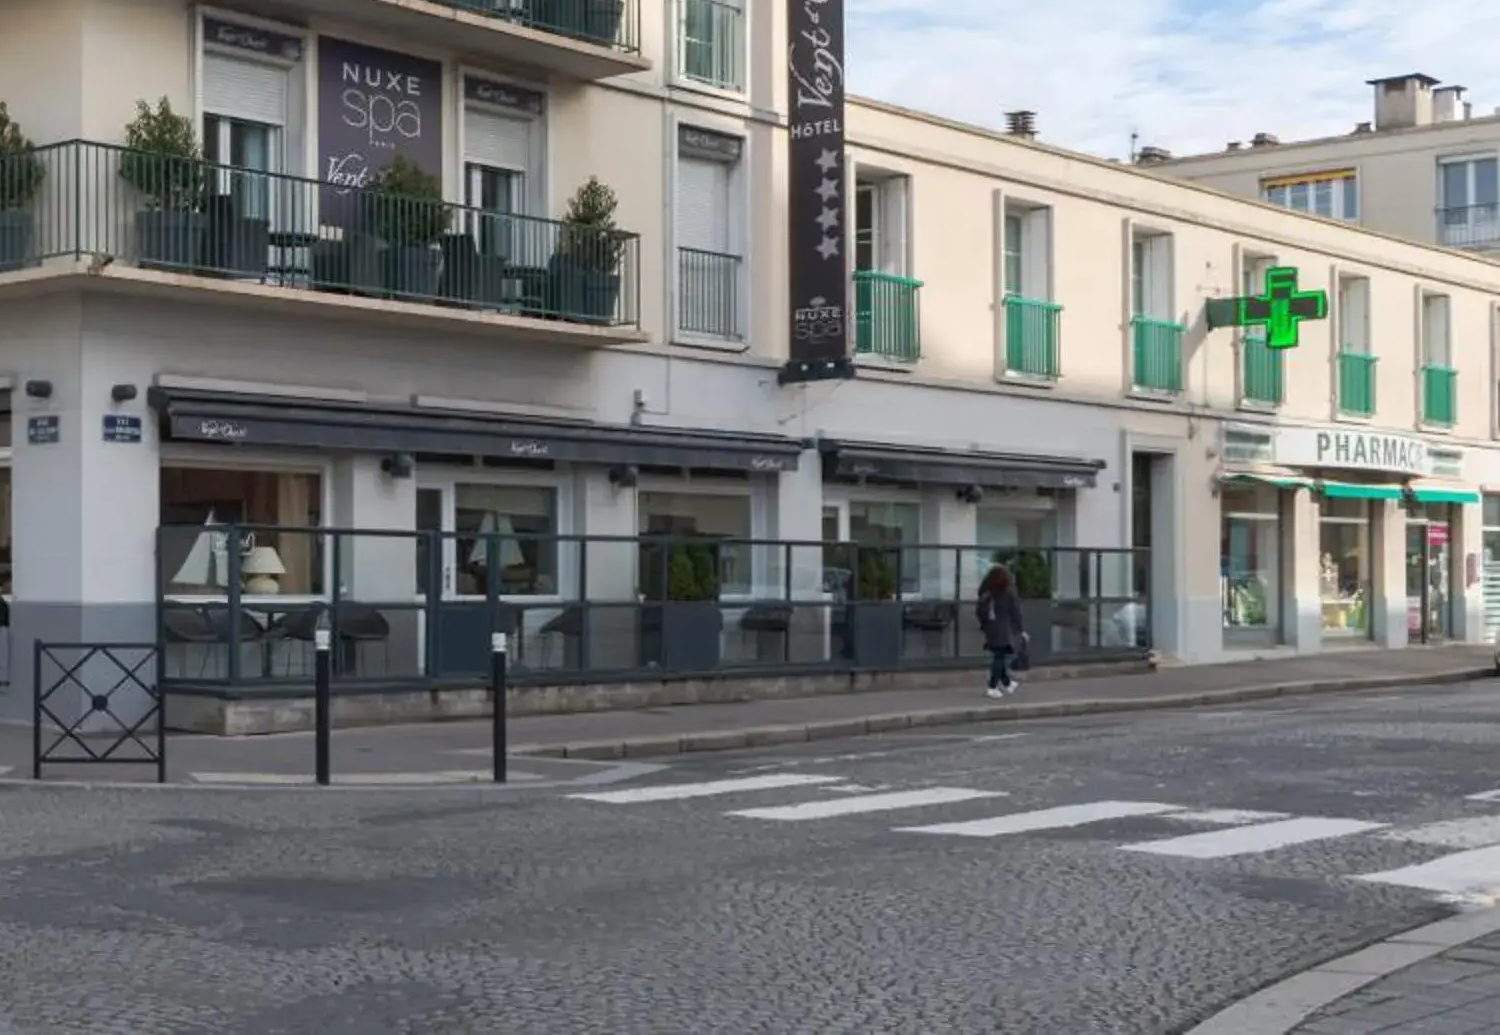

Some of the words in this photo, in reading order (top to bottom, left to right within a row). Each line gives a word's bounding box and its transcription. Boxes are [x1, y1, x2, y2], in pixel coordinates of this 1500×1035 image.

[342, 62, 421, 96] NUXE
[788, 27, 843, 108] Vent
[327, 153, 369, 195] Vent
